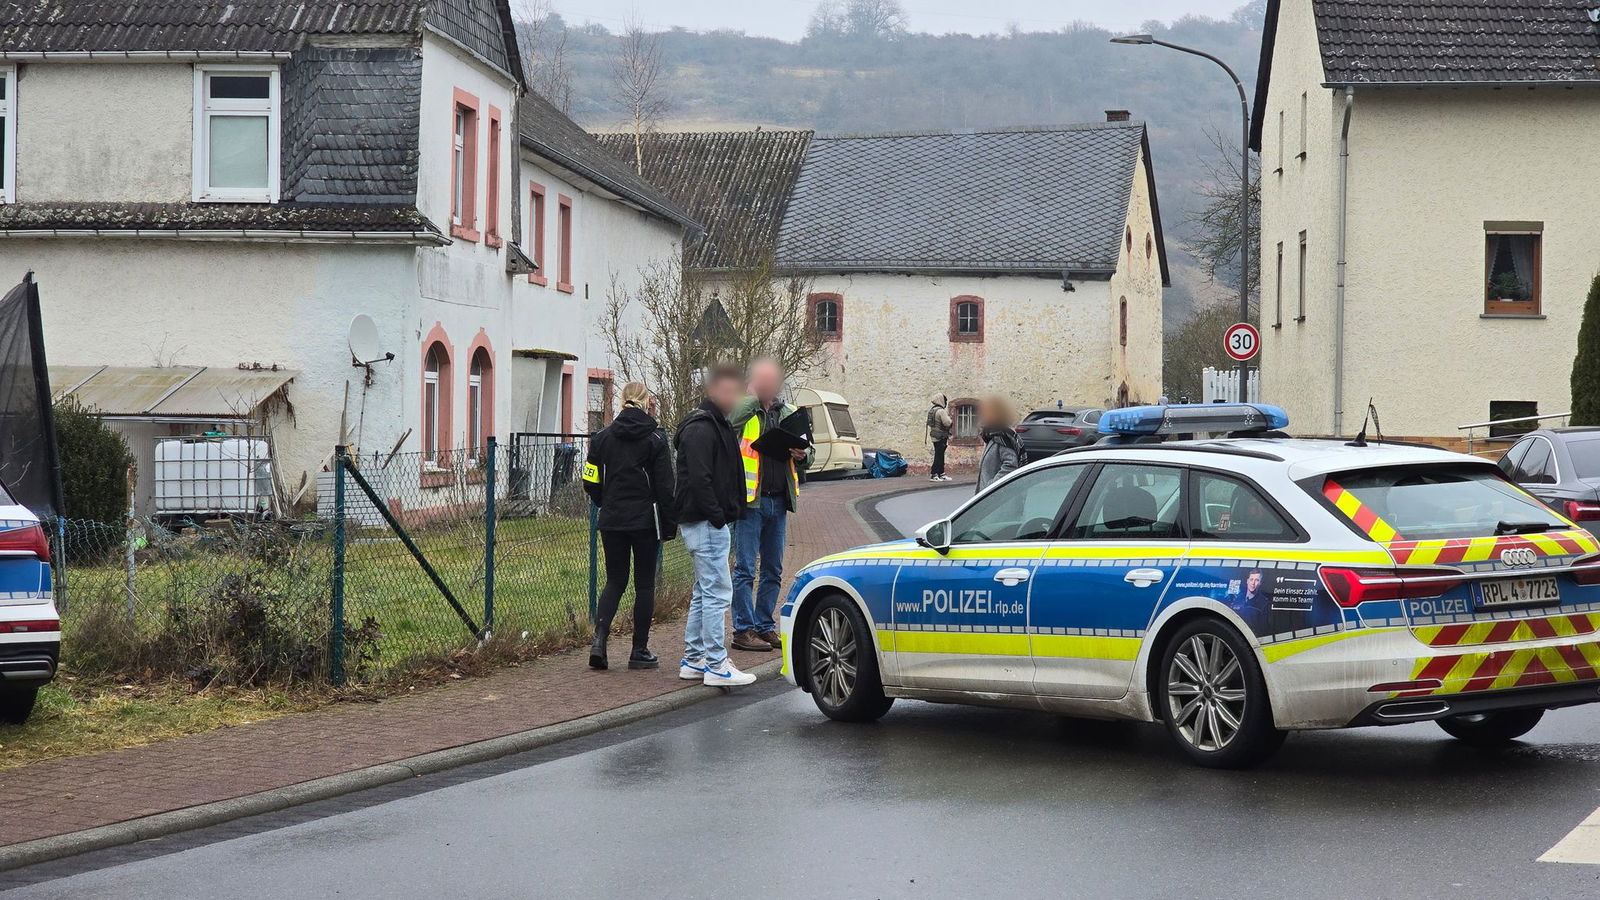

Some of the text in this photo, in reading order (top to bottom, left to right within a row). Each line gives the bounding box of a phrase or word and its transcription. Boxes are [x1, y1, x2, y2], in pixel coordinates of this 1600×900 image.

[1232, 334, 1252, 350] 30
[1482, 579, 1558, 603] RPL 4 7723
[896, 589, 1024, 617] www.POLIZEI.rlp.de
[1410, 599, 1468, 616] POLIZEI
